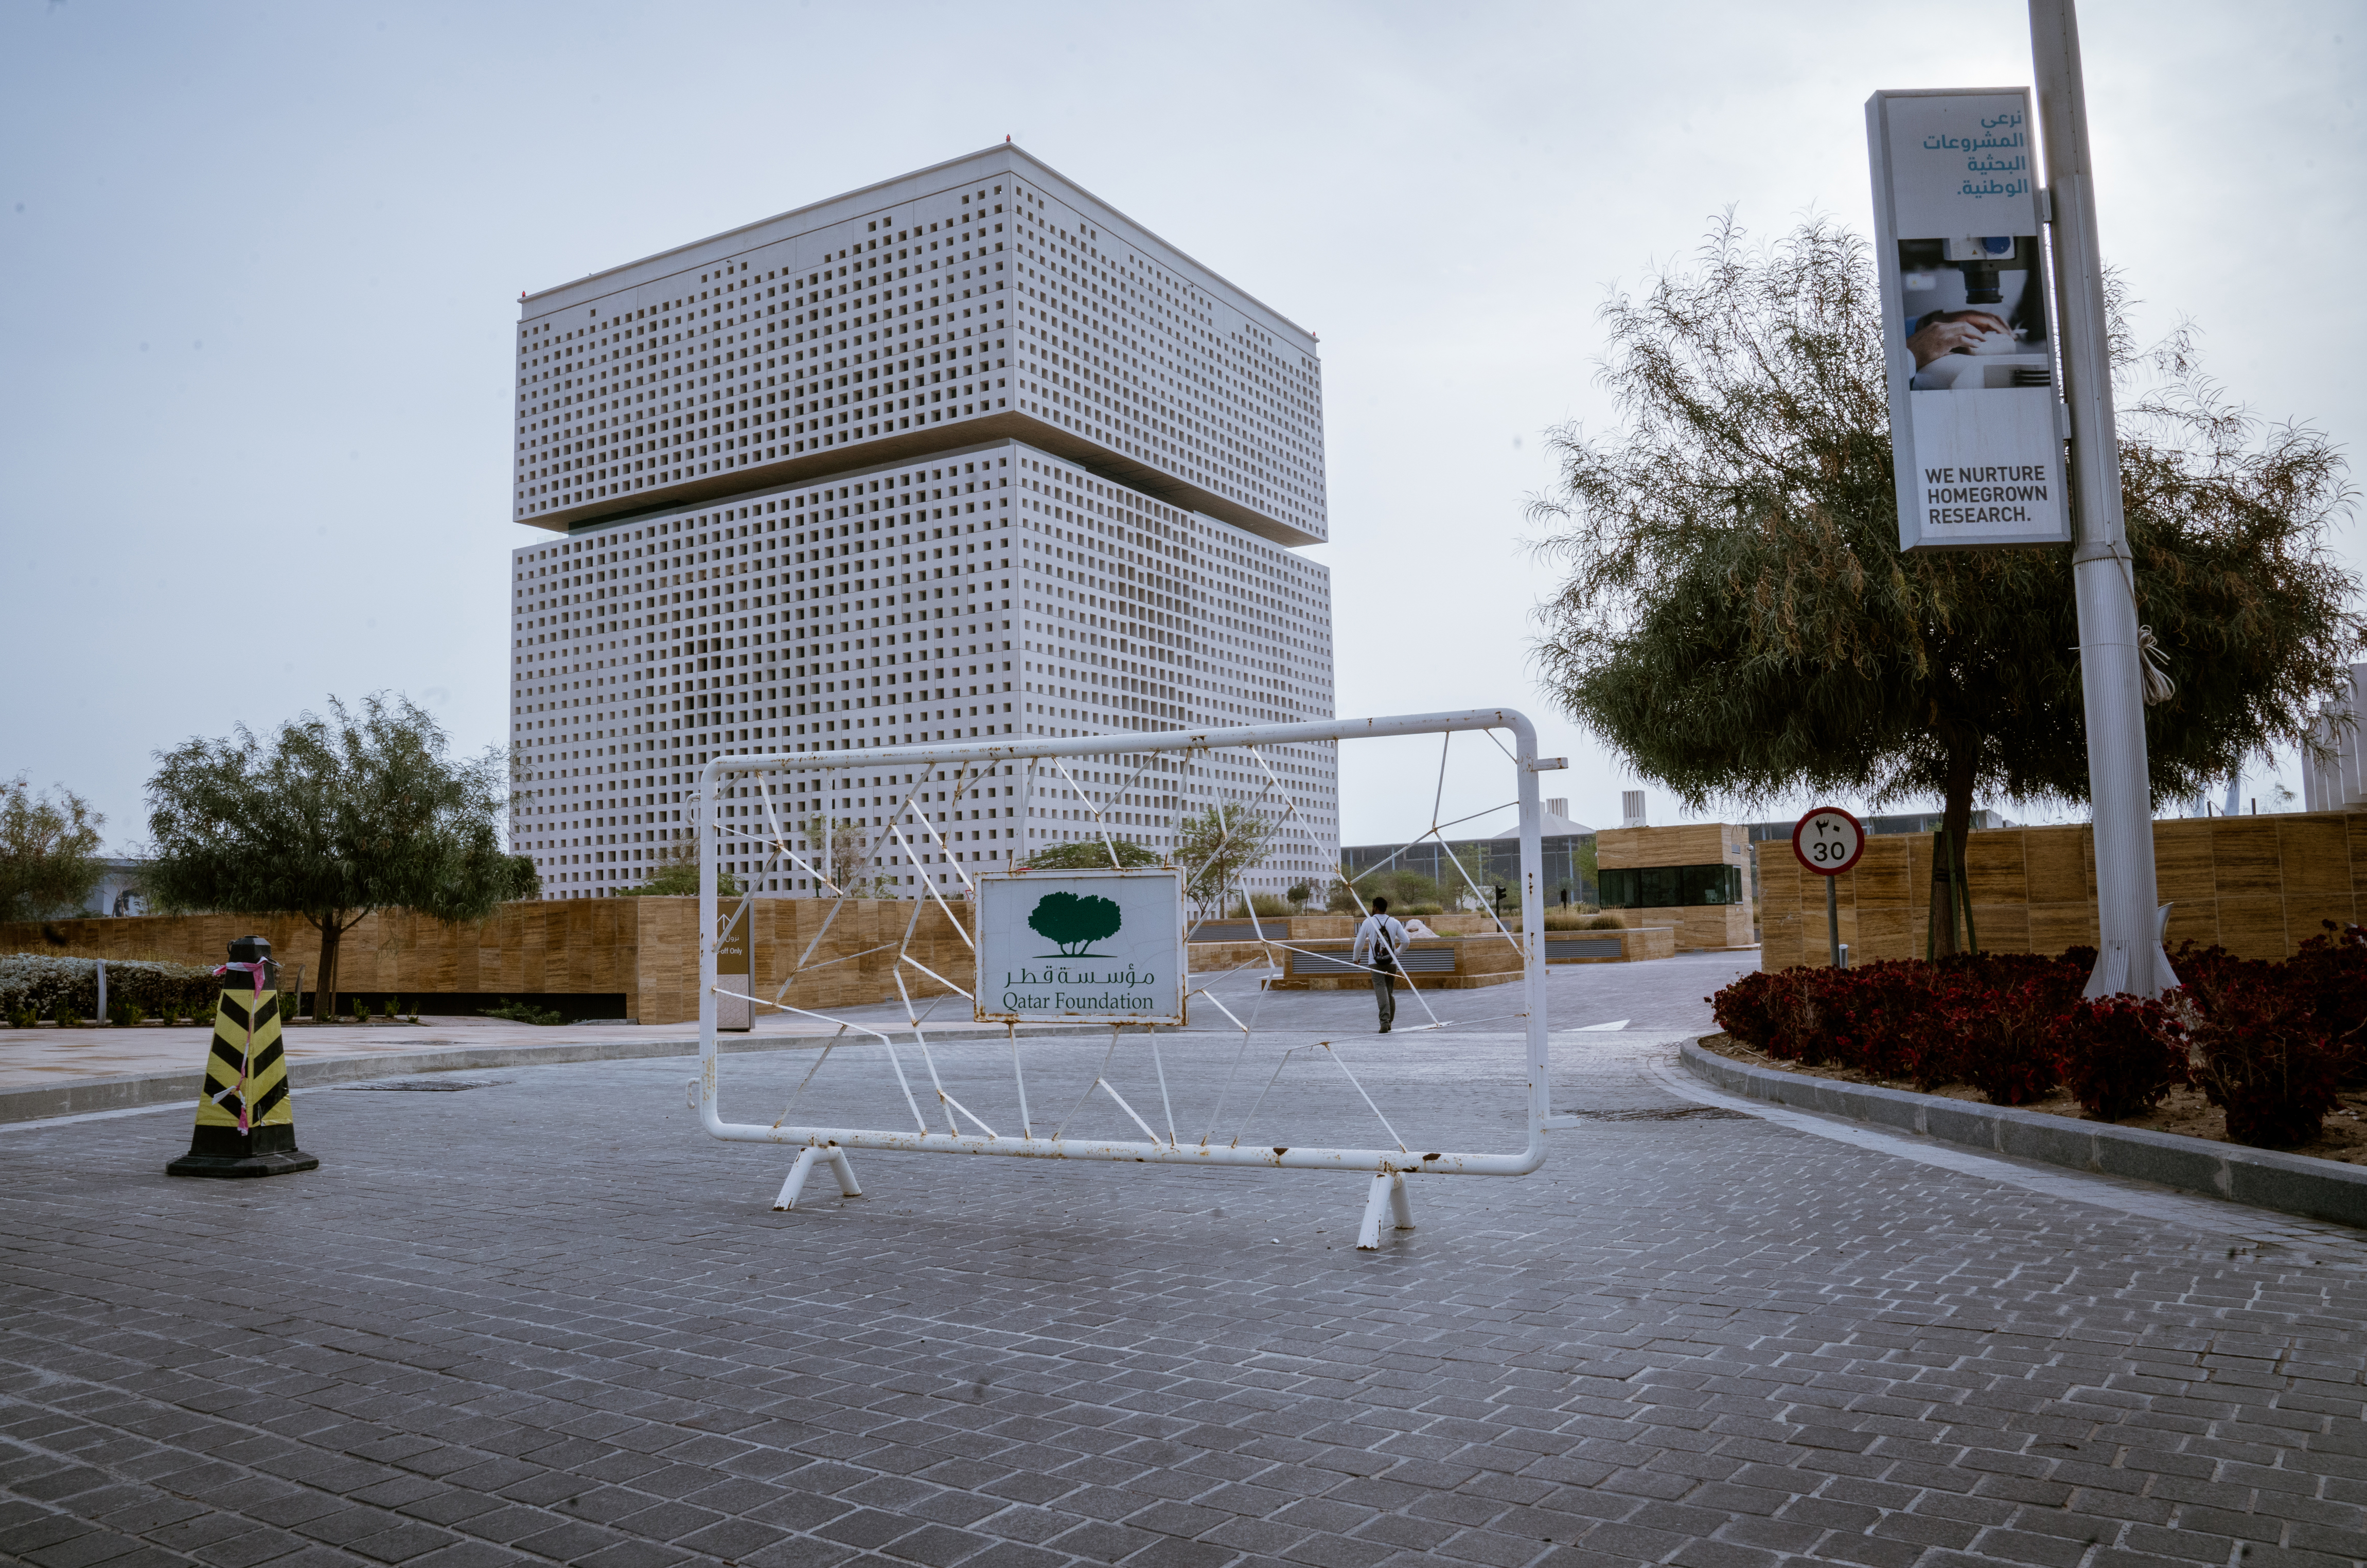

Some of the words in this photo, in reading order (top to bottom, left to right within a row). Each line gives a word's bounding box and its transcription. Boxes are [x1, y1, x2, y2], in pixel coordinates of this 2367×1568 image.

[1981, 111, 2022, 128] نرعى
[1923, 131, 2024, 152] المشروعات
[1967, 154, 2026, 175] البحثية
[1957, 179, 2028, 199] الوطنية.
[1925, 468, 1954, 484] WE
[1959, 466, 2045, 483] NURTURE
[1928, 486, 2048, 504] HOMEGROWN
[1930, 506, 2031, 524] RESEARCH.
[1813, 842, 1845, 862] 30
[730, 947, 742, 955] Only
[1003, 965, 1053, 988] قطر
[1058, 964, 1155, 988] مؤسسة
[1003, 992, 1050, 1011] Qatar
[1054, 992, 1154, 1009] Foundation
